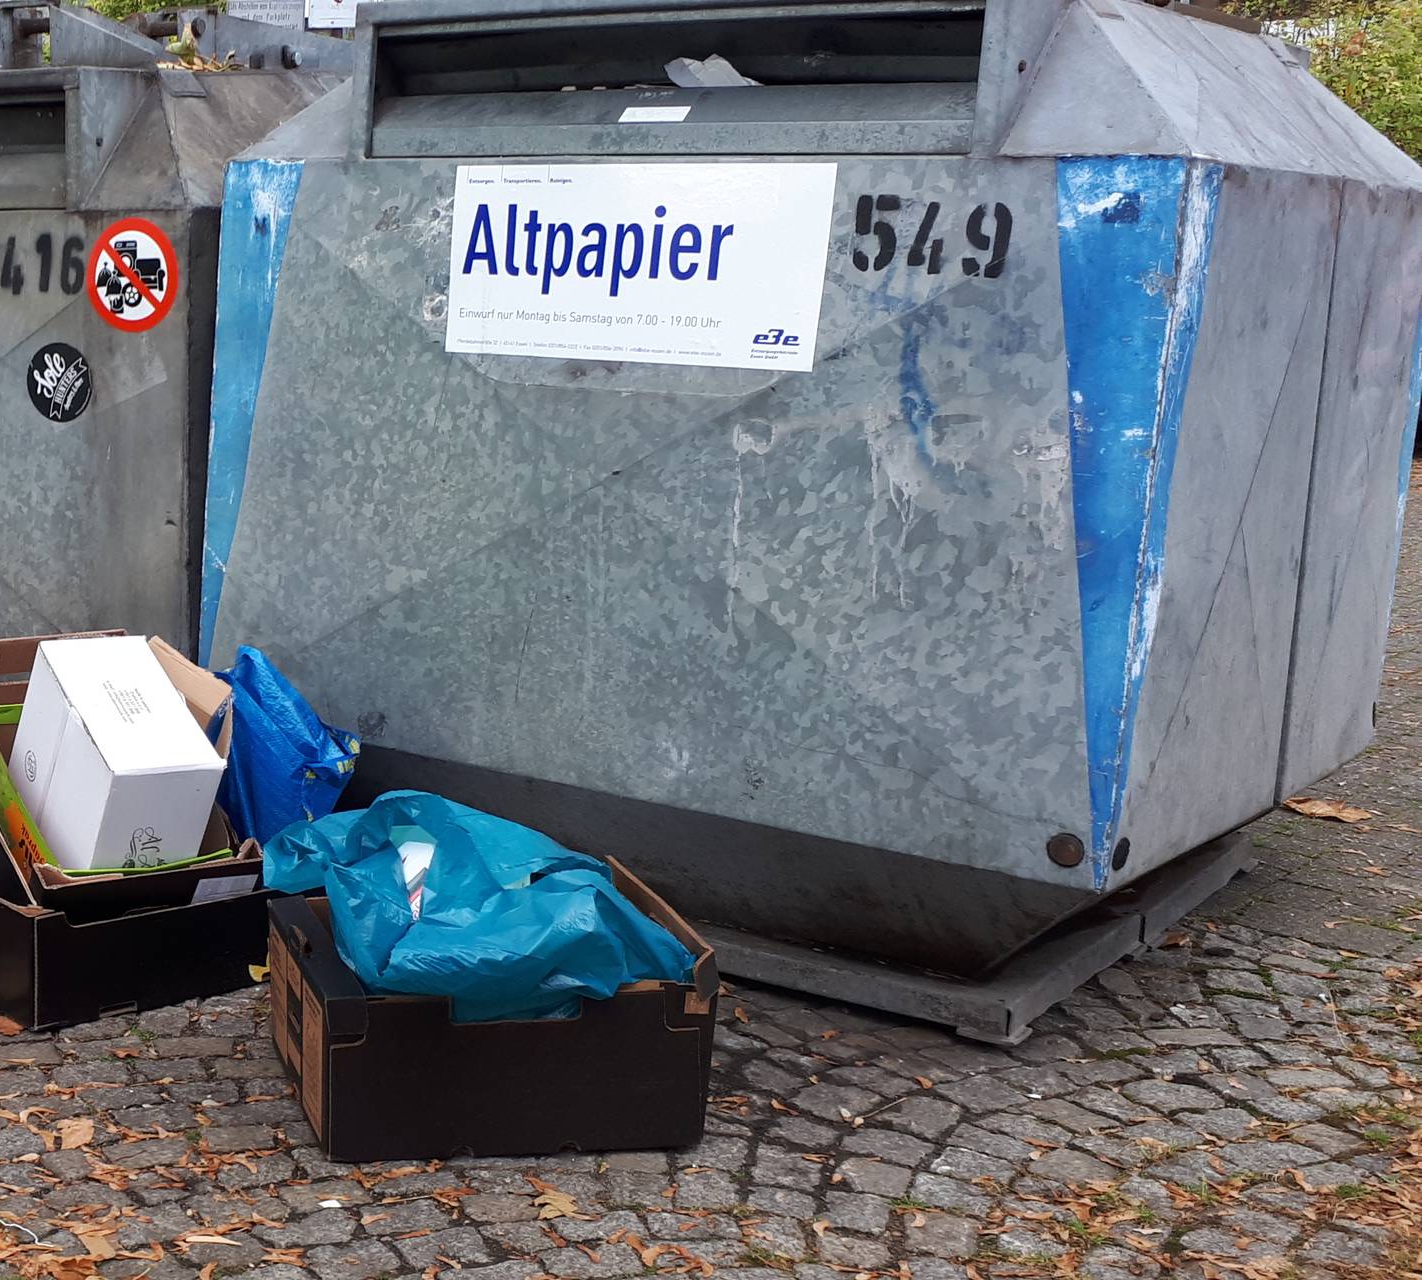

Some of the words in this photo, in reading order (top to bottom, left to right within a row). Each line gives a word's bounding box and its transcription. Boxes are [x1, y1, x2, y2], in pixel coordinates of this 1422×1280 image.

[0, 233, 85, 295] 416
[462, 203, 734, 297] Altpapier
[853, 194, 1013, 279] 549
[459, 307, 495, 319] Einwurf
[498, 310, 513, 319] nur
[516, 310, 550, 324] Montag
[553, 311, 566, 322] bis
[570, 312, 612, 326] Samstag
[616, 316, 633, 325] von
[637, 314, 658, 326] 7.00
[671, 315, 698, 327] 19.00
[701, 317, 722, 328] Uhr
